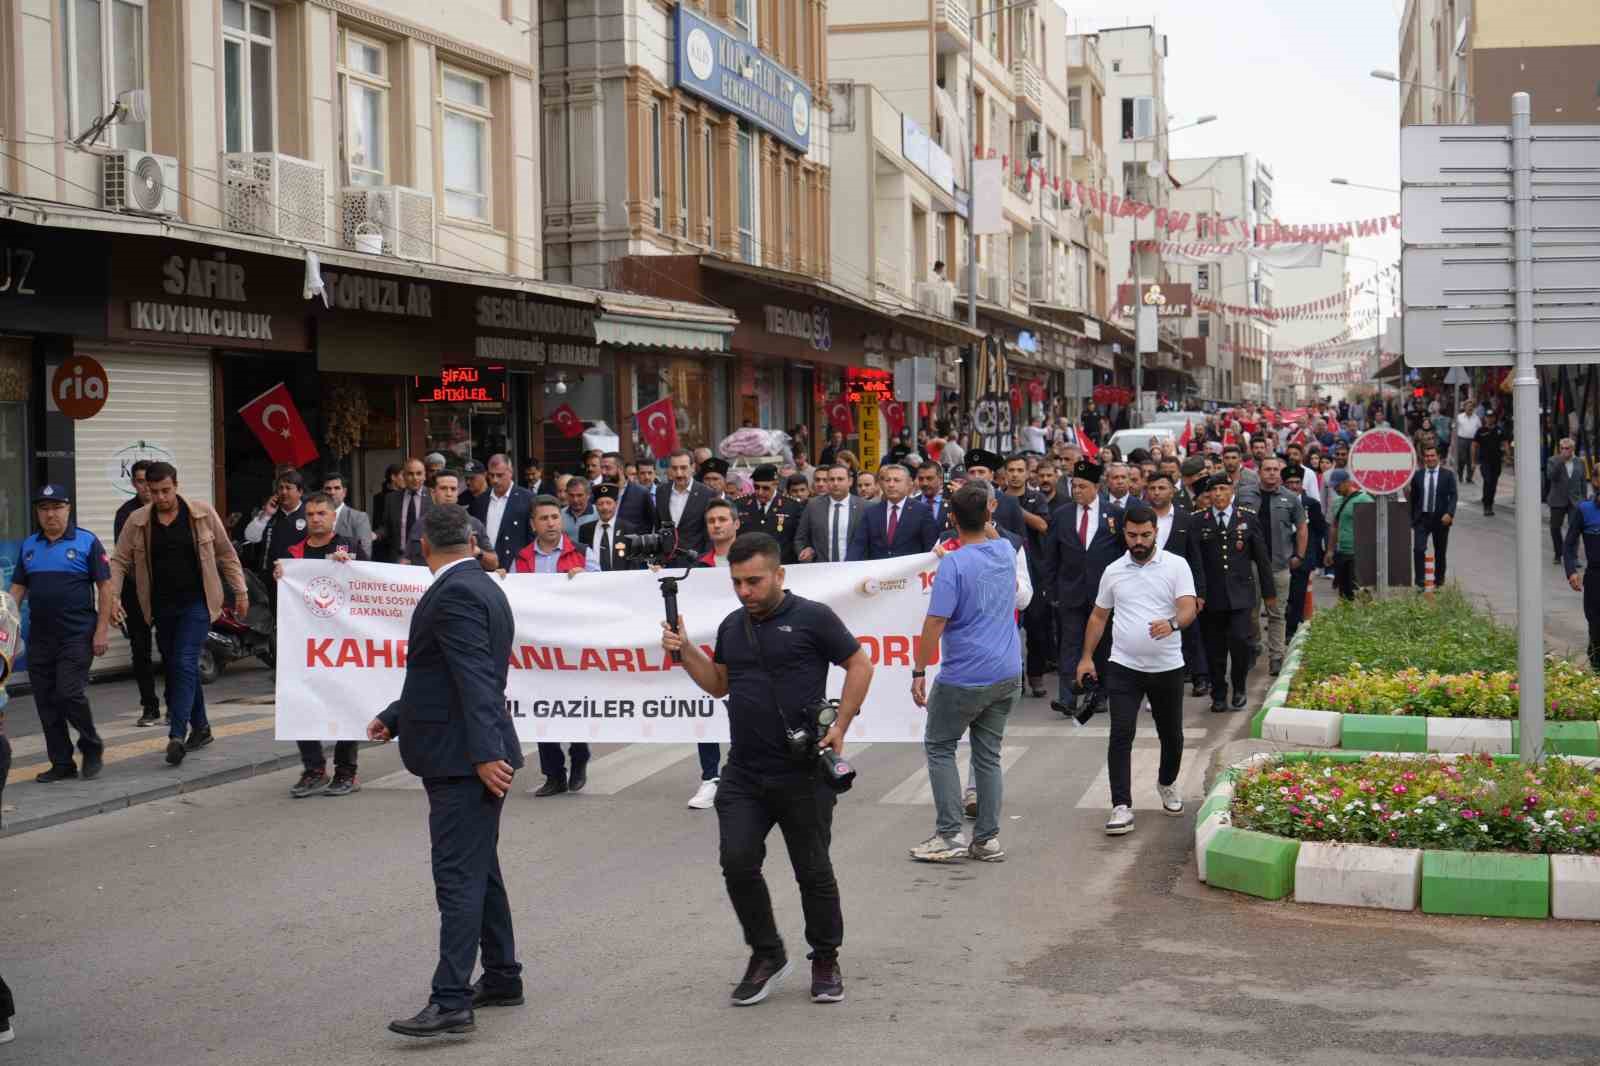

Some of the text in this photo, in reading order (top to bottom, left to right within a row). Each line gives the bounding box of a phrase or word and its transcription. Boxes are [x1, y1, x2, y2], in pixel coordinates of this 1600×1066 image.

[162, 251, 247, 301] SAFİR
[328, 273, 432, 318] TOPUZLAR
[130, 300, 273, 340] KUYUMCULUK
[548, 343, 601, 368] BAHARAT
[59, 365, 104, 400] ria
[442, 369, 478, 385] ŞİFALI
[433, 385, 487, 401] BİTKİLER
[349, 580, 388, 592] TÜRKİYE
[371, 595, 384, 605] VE
[385, 596, 417, 606] SOSYA
[350, 607, 402, 618] BAKANLIĞI
[532, 697, 635, 718] GAZİLER
[642, 696, 715, 719] GÜNÜ
